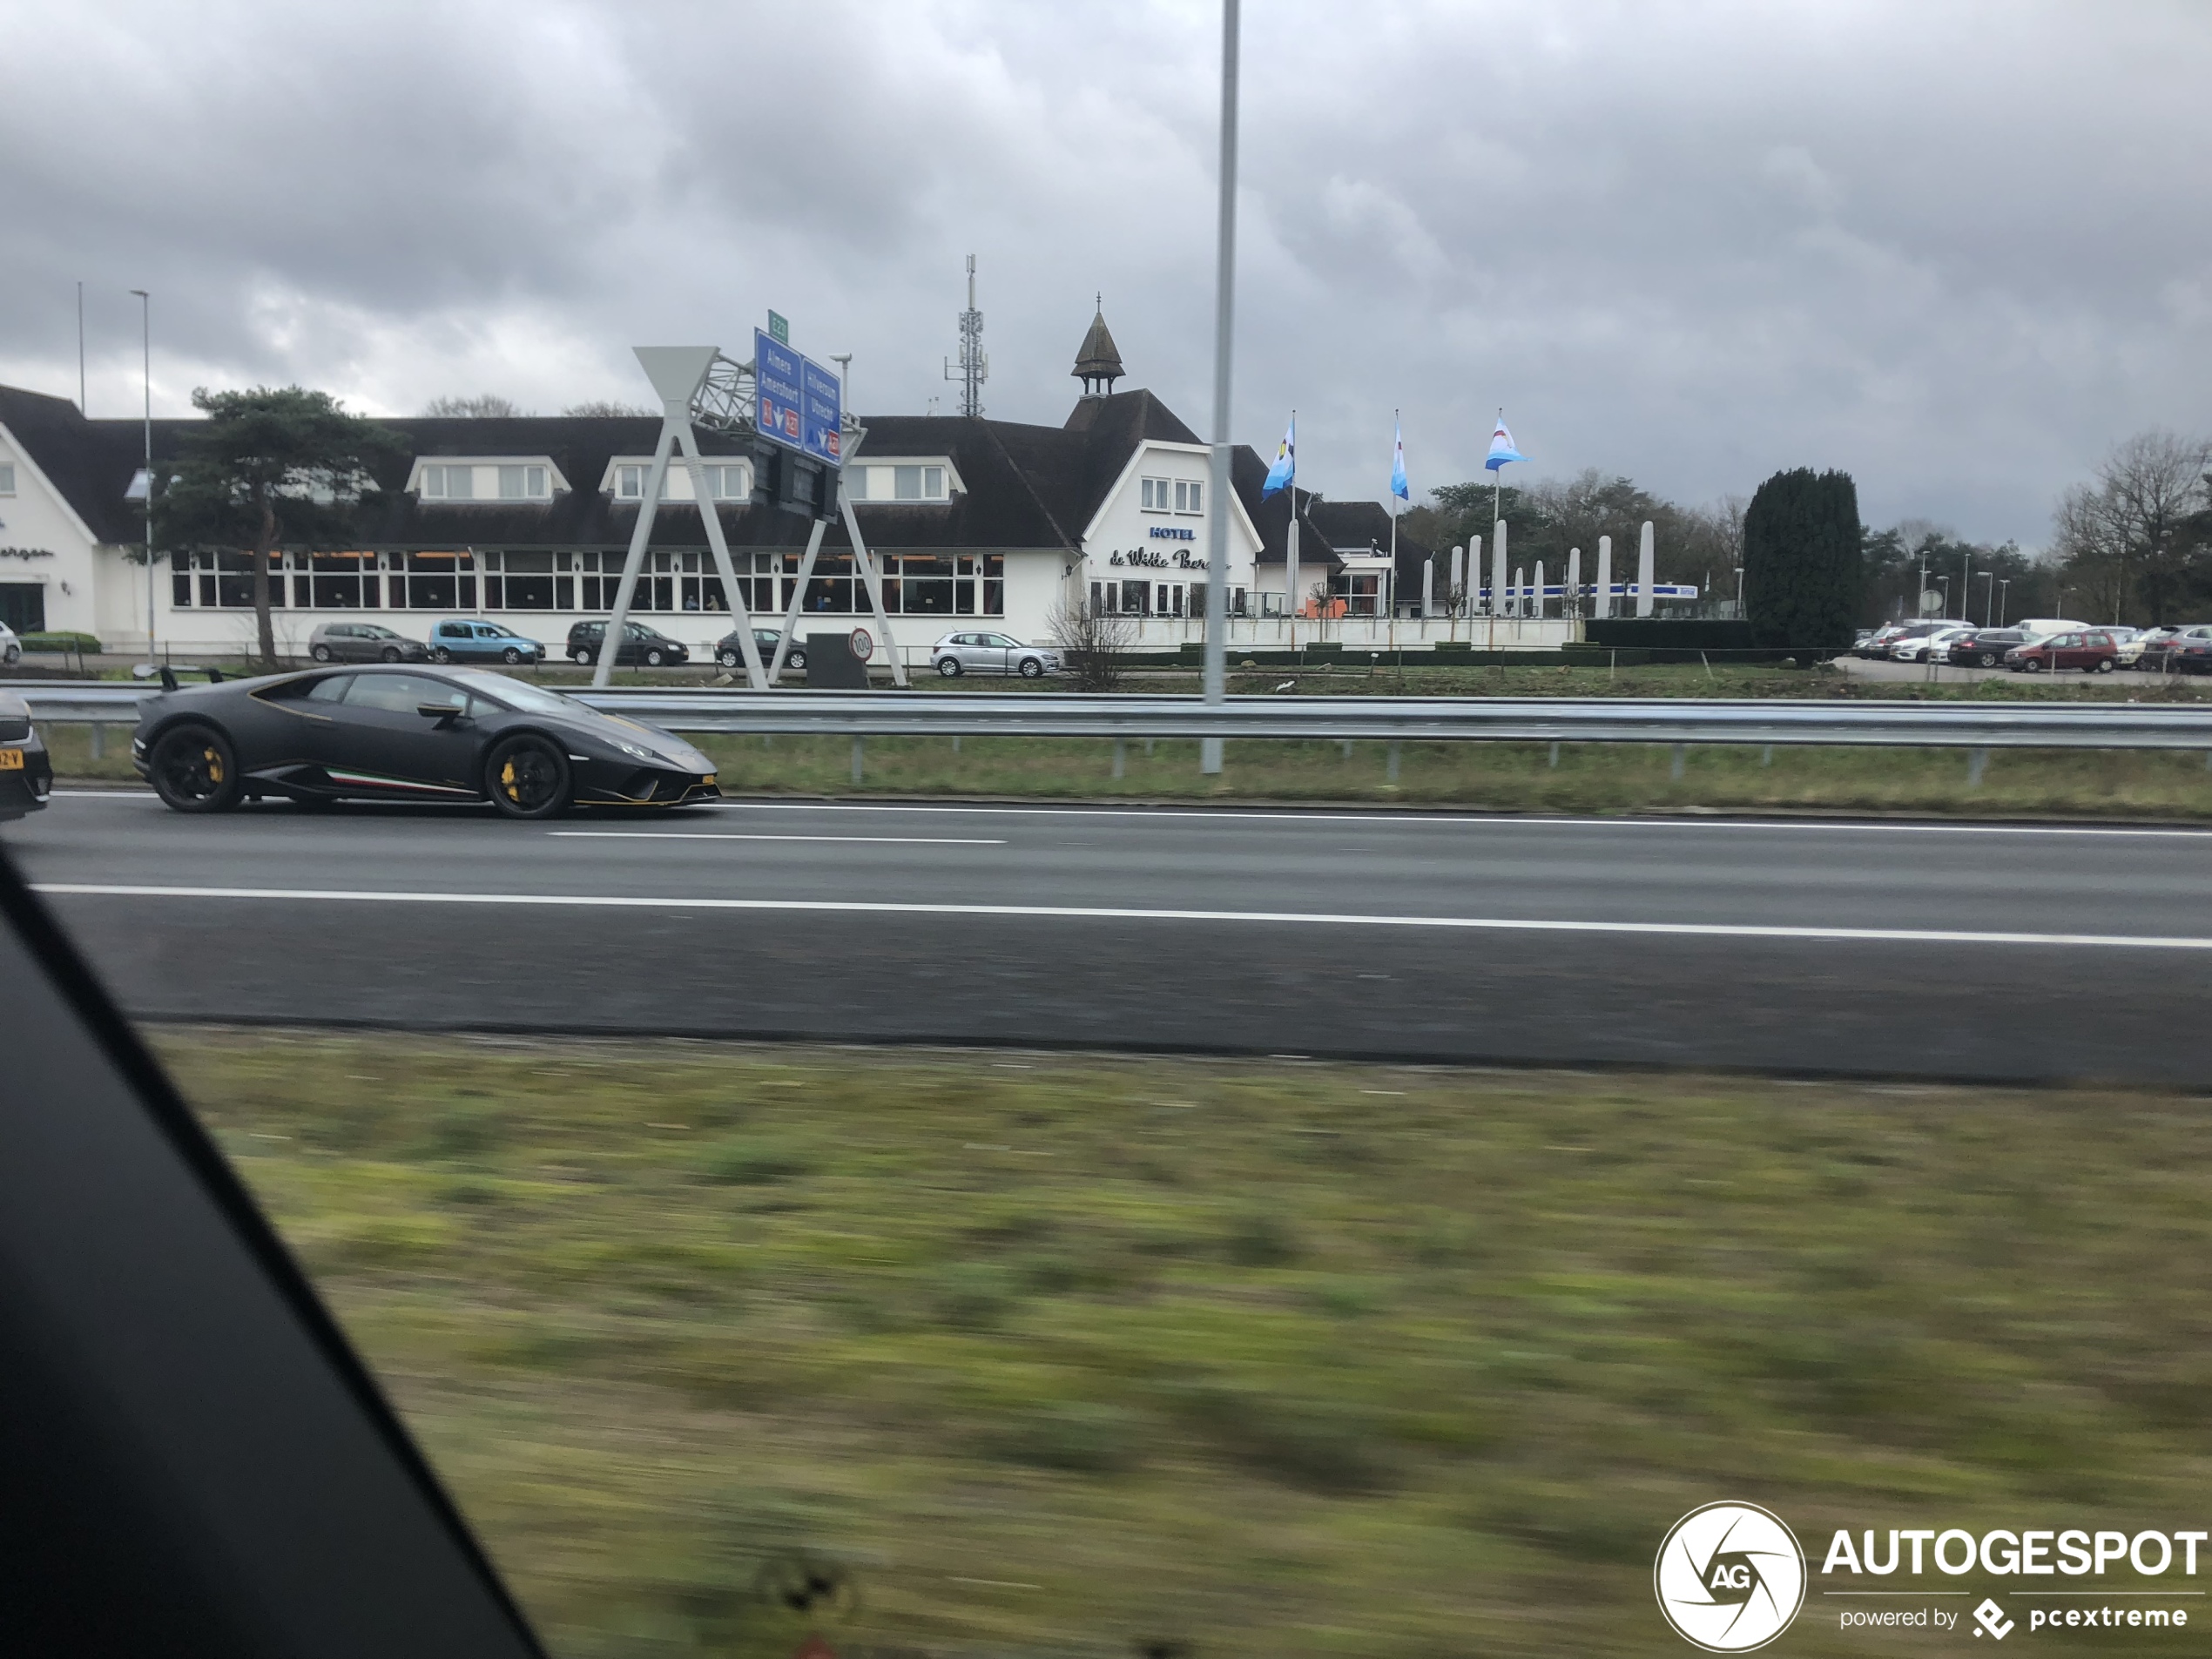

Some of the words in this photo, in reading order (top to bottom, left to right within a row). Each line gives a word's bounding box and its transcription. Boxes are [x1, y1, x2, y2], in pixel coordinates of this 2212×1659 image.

[767, 348, 792, 375] Almere
[761, 371, 799, 404] Amersfoort
[807, 370, 836, 401] Hilversum
[811, 396, 833, 422] Utrecht
[1150, 527, 1197, 540] HOTEL
[1109, 549, 1125, 566] de
[1126, 546, 1170, 567] Witte
[854, 636, 870, 653] 100
